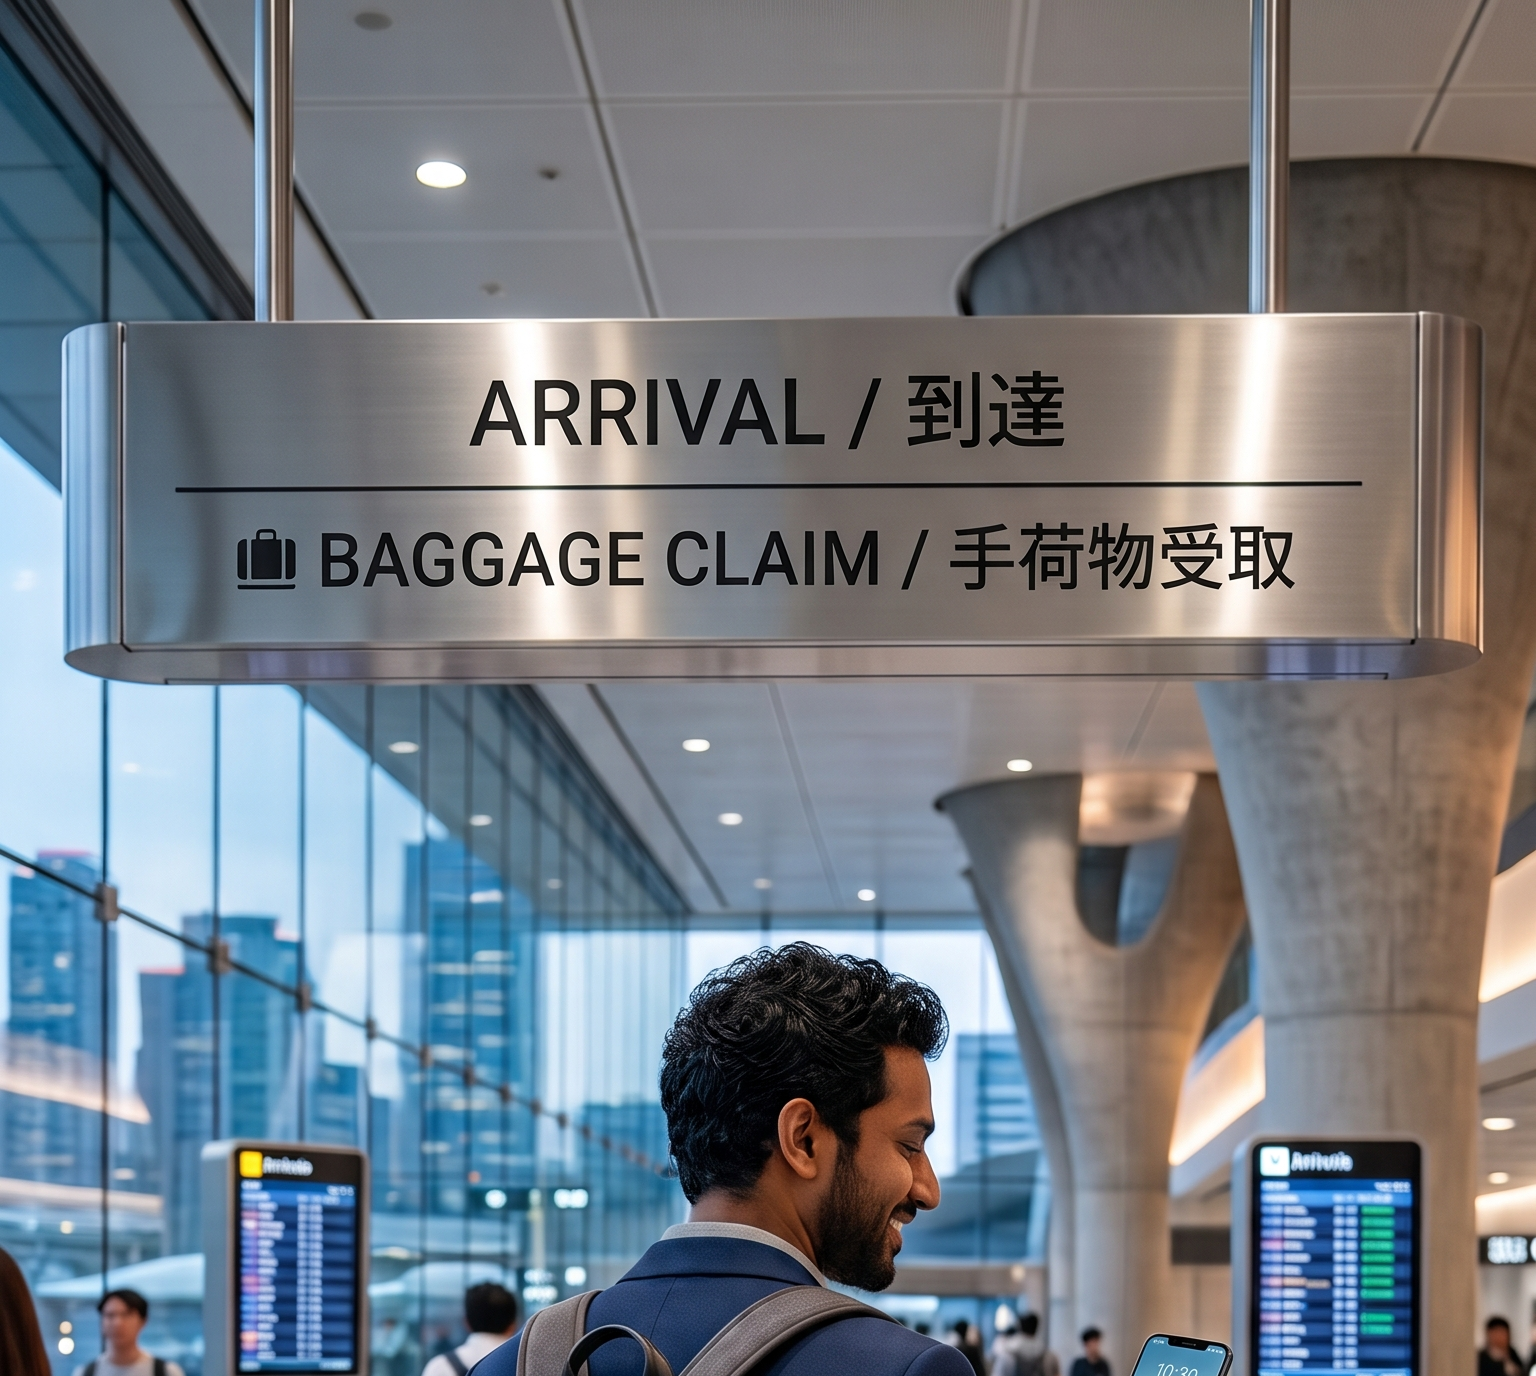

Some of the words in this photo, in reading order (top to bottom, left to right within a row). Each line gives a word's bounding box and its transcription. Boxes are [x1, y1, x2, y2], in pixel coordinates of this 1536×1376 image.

[470, 378, 825, 446] ARRIVAL
[848, 378, 881, 449] /
[907, 371, 1064, 448] 到達
[322, 532, 643, 587] BAGGAGE
[667, 531, 878, 586] CLAIM
[901, 529, 929, 590] /
[950, 522, 1295, 590] 手荷物受取
